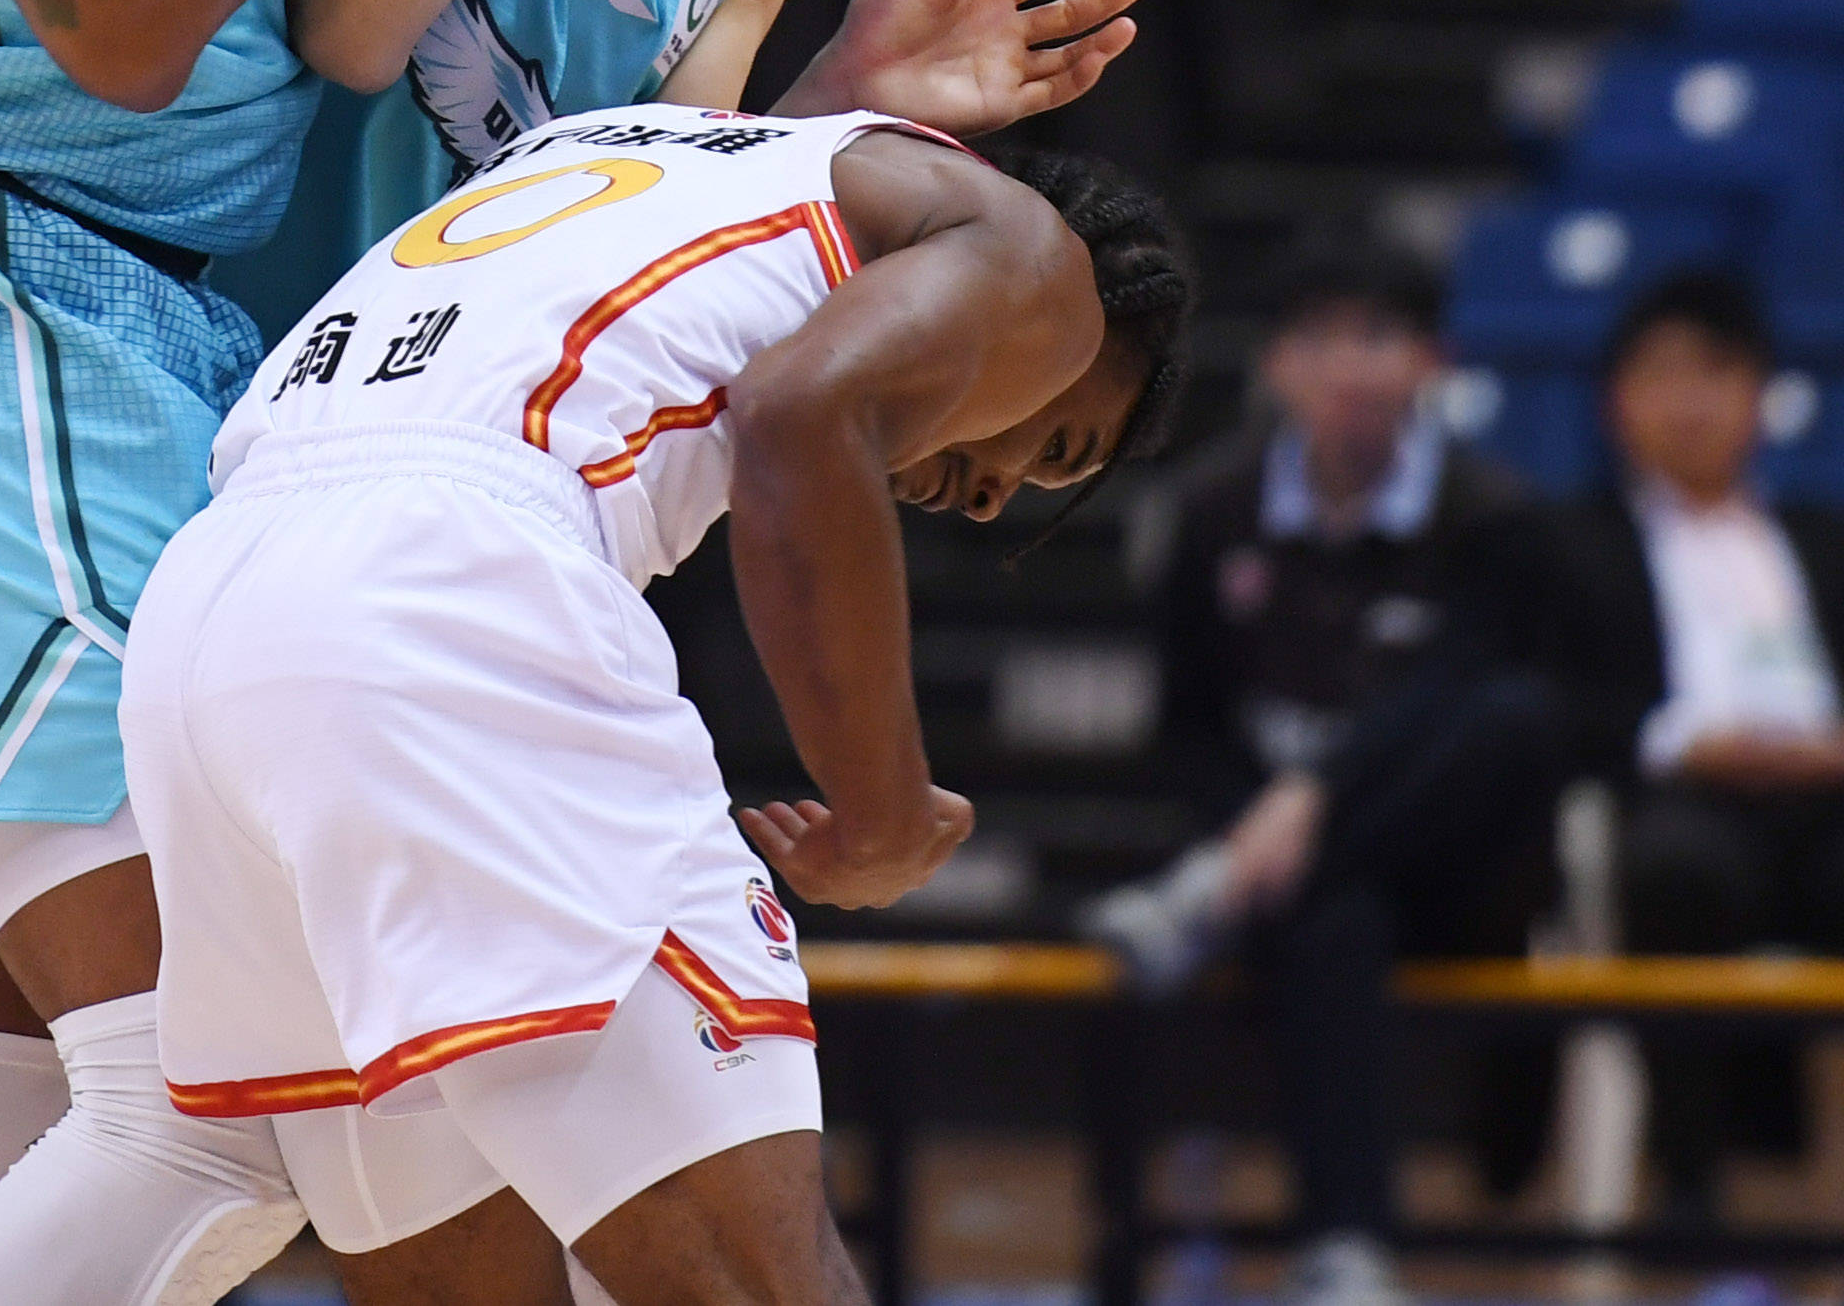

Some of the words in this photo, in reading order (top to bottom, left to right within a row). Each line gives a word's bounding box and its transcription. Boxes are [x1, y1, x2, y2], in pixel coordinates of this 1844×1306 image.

[392, 157, 665, 269] 0
[765, 945, 797, 964] CBA
[713, 1053, 757, 1073] CBA
